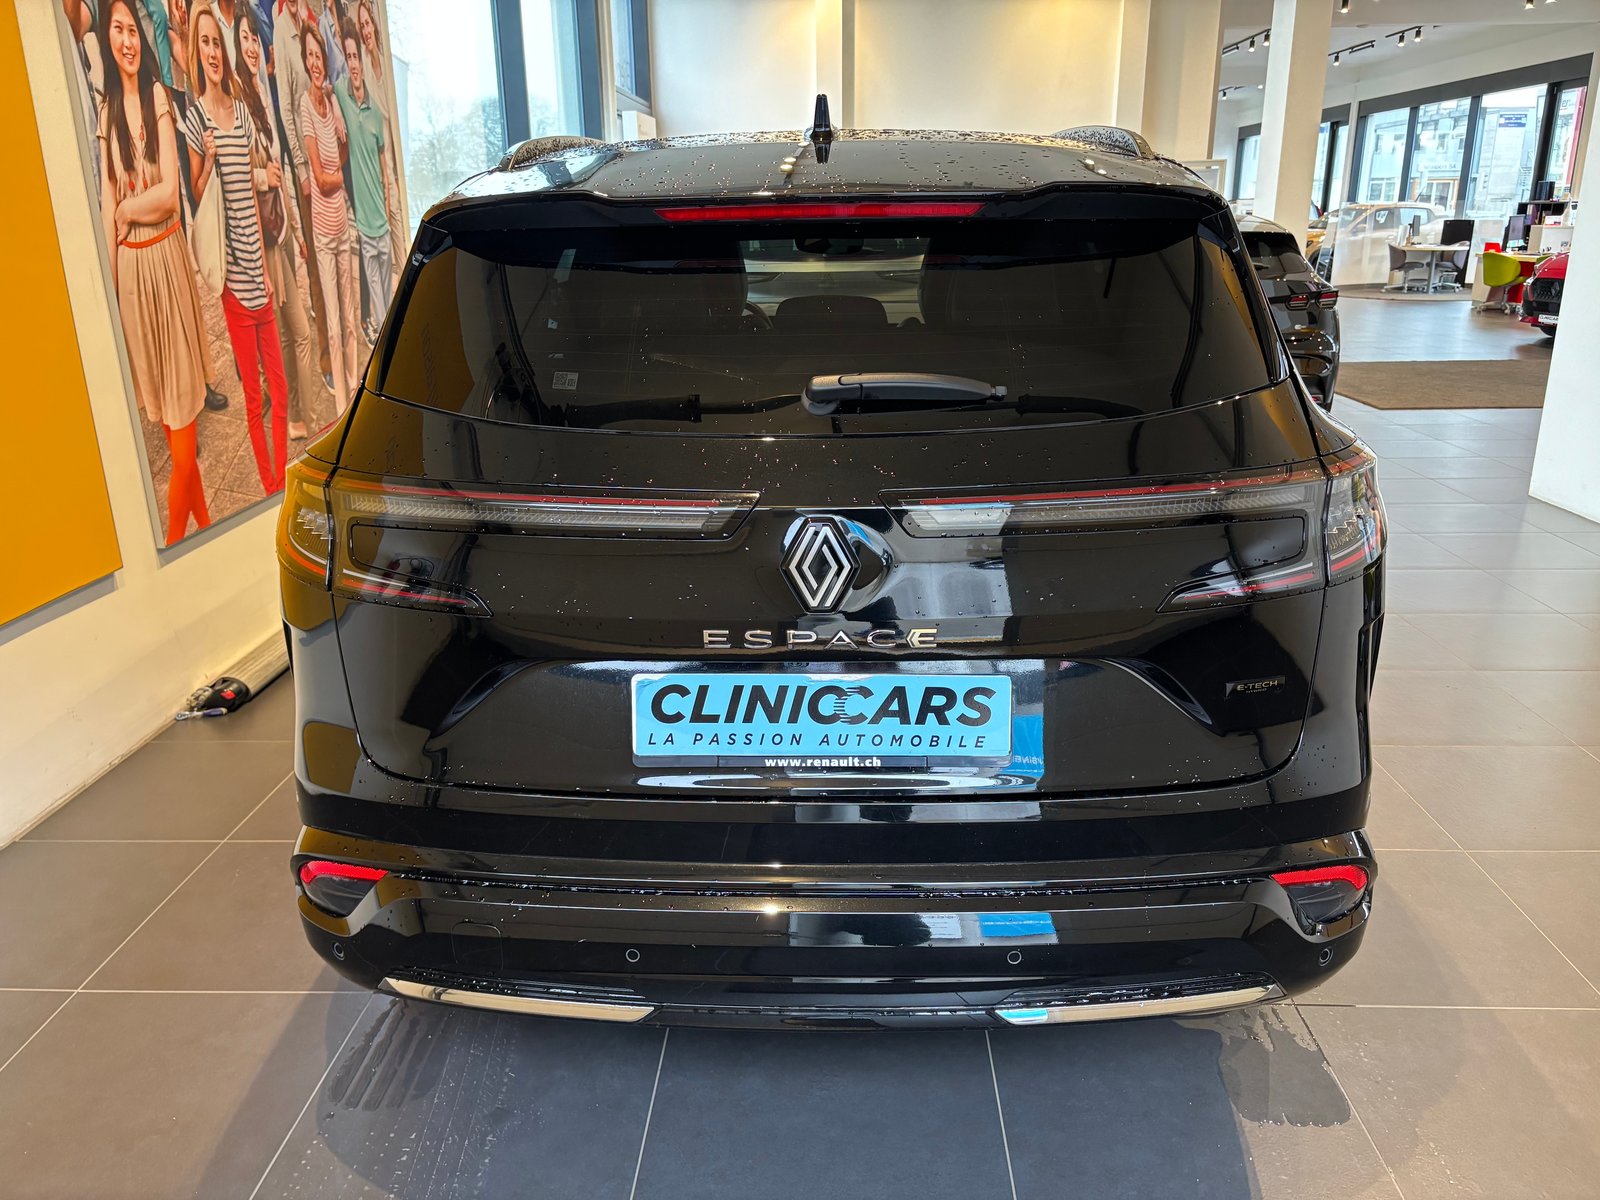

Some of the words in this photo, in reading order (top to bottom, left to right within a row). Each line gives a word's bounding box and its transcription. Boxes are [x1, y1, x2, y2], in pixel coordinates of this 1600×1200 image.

[703, 628, 938, 649] ESPACE
[1236, 680, 1278, 691] E-TECH
[651, 684, 997, 727] CLINICCARS
[648, 733, 675, 746] LA
[693, 733, 802, 746] PASSION
[819, 733, 986, 748] AUTOMOBILE
[765, 756, 881, 767] www.renault.ch
